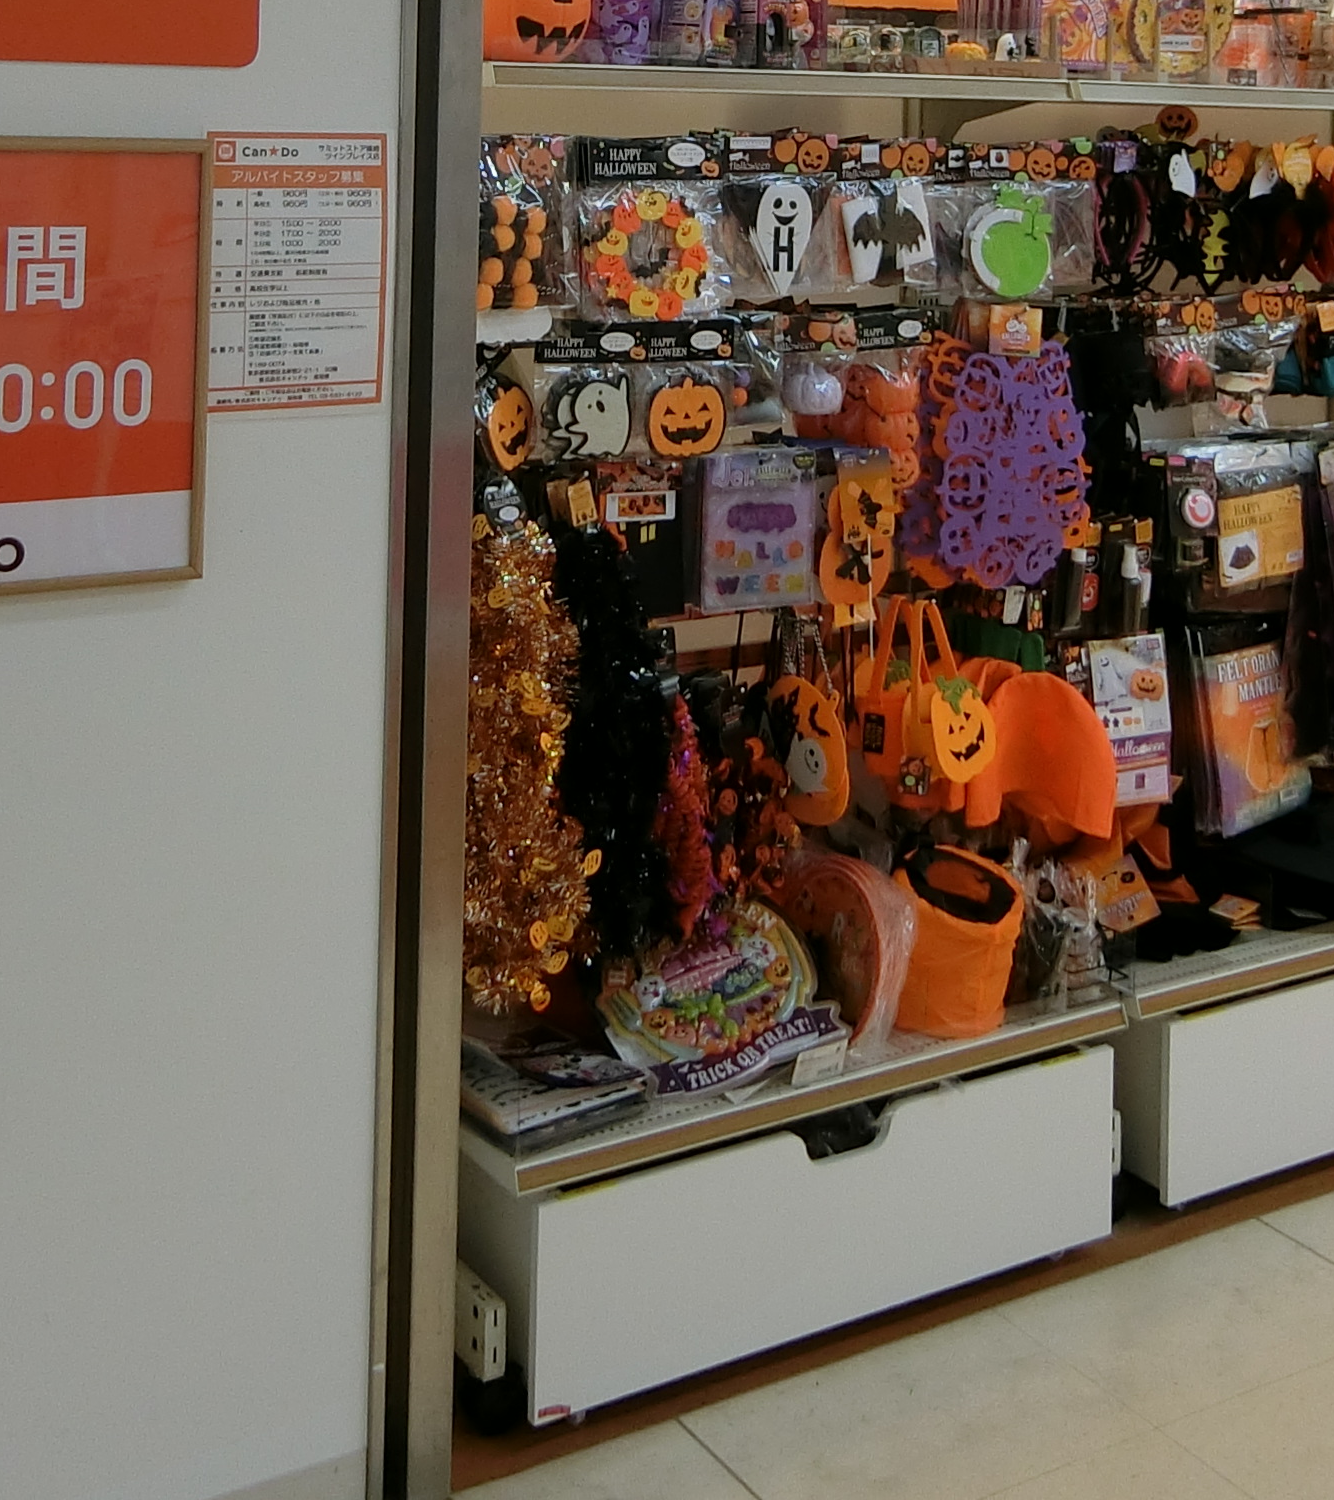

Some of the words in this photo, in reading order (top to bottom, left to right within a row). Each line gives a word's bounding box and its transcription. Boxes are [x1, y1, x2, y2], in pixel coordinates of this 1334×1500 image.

[242, 146, 267, 157] Can
[281, 147, 299, 157] Do
[609, 148, 643, 163] HAPPY
[594, 161, 657, 176] HALLOWEEN
[231, 169, 365, 184] アルバイトスタッフ募集
[772, 226, 795, 273] H
[557, 337, 585, 348] HAPPY
[651, 337, 676, 348] HAPPY
[543, 346, 597, 359] HALLOWEEN
[649, 347, 688, 358] LLOWEEN
[1217, 659, 1249, 684] FELT
[1251, 649, 1280, 672] ORAN
[686, 1060, 735, 1090] TRICK
[737, 1045, 761, 1067] OR
[755, 1016, 812, 1056] TREAT!
